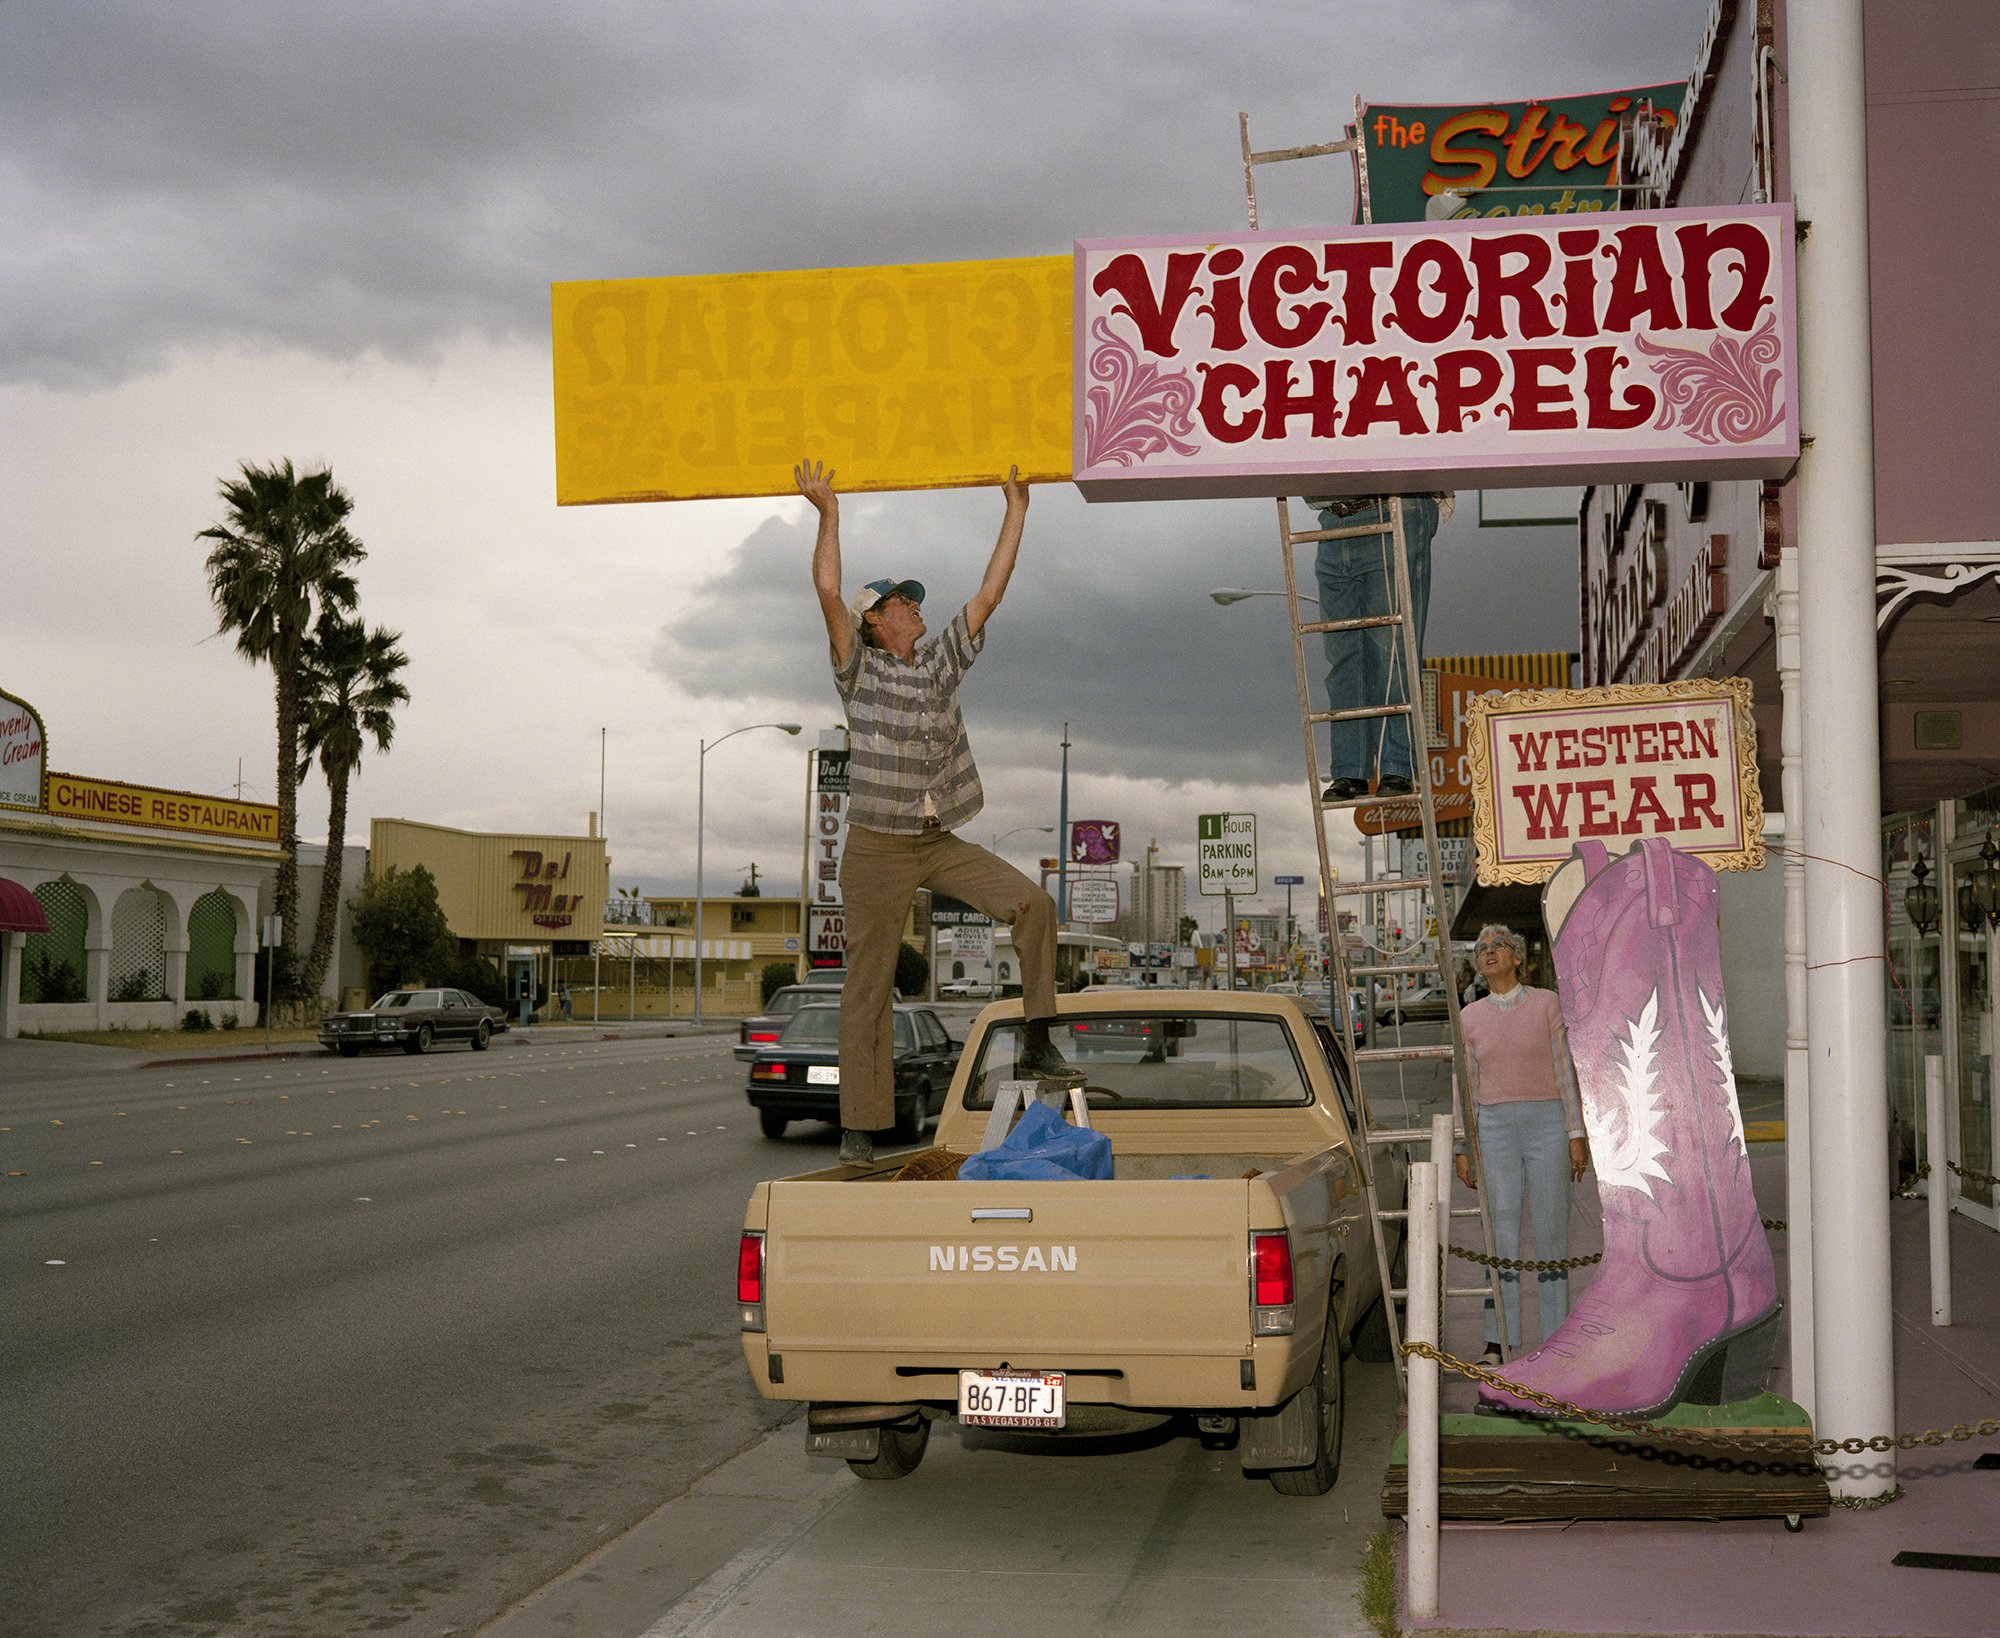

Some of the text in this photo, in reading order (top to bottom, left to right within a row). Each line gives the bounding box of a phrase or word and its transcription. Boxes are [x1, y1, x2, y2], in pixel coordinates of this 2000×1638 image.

[1373, 113, 1426, 149] the
[1421, 97, 1677, 197] Stri
[1196, 346, 1656, 444] CHAPEL
[0, 710, 31, 741] venly
[3, 741, 41, 766] Cream
[1508, 717, 1719, 772] WESTERN
[14, 792, 37, 804] CREAM
[57, 784, 272, 832] CHINESE RESTAURANT
[1512, 772, 1725, 841] WEAR
[1206, 818, 1252, 836] 1 HOUR
[818, 793, 840, 902] MOTEL
[1203, 843, 1252, 860] PARKING
[510, 850, 571, 880] Del
[513, 883, 584, 912] Mar
[535, 915, 571, 924] OFFICE
[932, 911, 990, 923] CREDIT CARDS
[929, 1246, 1078, 1272] NISSAN
[966, 1415, 1056, 1427] LAS VEGAS DODGE
